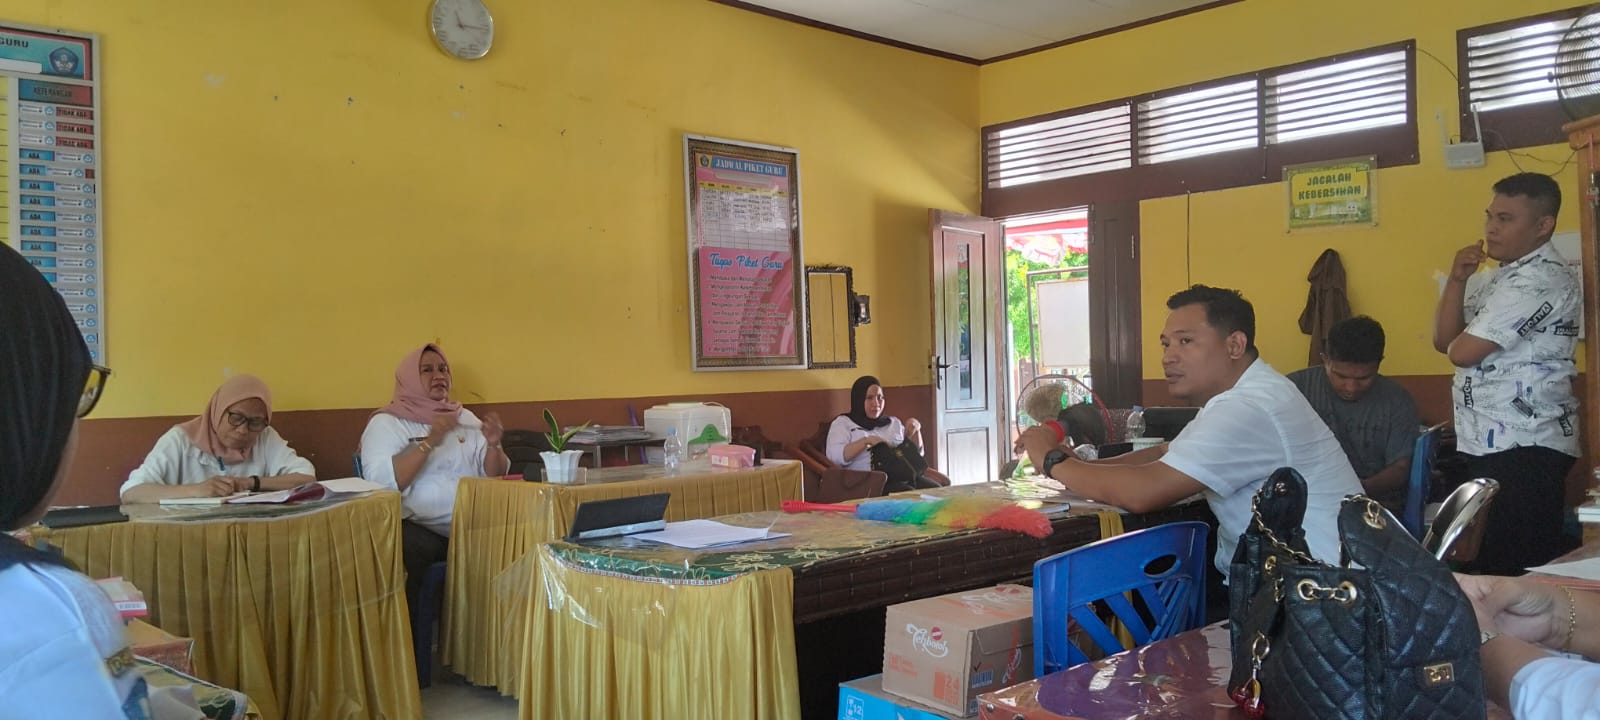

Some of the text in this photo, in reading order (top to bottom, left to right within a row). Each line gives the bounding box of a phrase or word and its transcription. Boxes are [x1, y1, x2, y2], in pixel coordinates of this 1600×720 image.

[0, 37, 29, 48] GURU
[716, 159, 783, 175] JADWAL PIKET GURU
[1298, 185, 1361, 201] KEBERSIHAN
[1519, 303, 1551, 336] VALFORT
